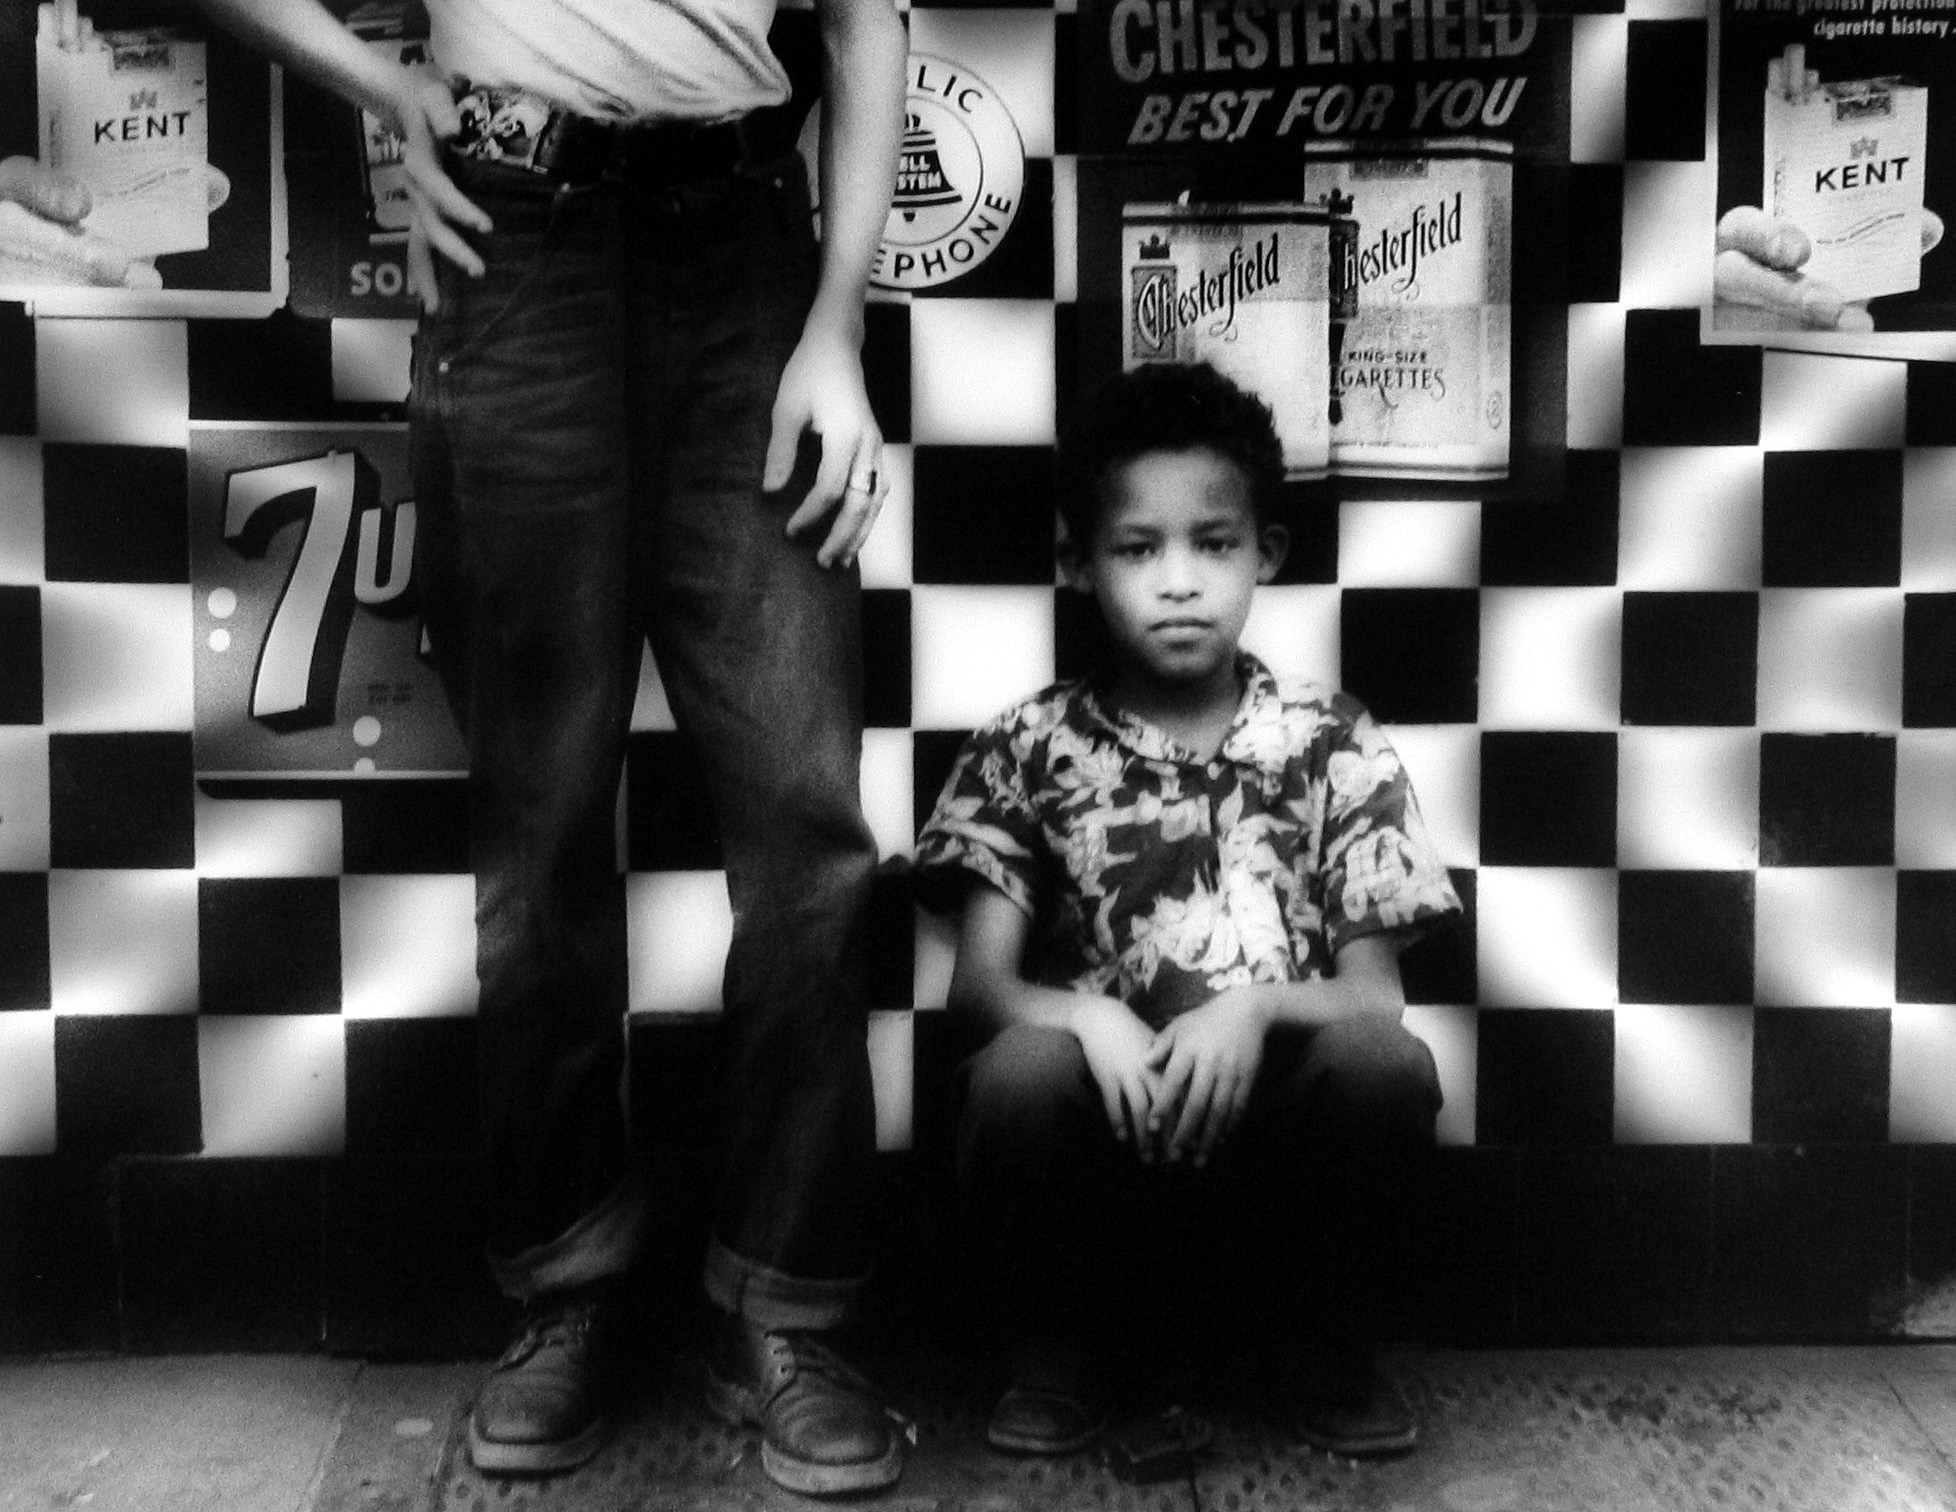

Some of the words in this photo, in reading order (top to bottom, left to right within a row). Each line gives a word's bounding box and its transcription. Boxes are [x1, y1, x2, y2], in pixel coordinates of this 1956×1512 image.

[1109, 0, 1538, 83] CHESTERFIELD
[1813, 17, 1885, 40] cigarette
[916, 64, 984, 114] LIC
[1127, 89, 1275, 145] BEST
[1276, 84, 1395, 137] FOR
[1411, 77, 1528, 129] YOU
[94, 112, 192, 145] KENT
[897, 170, 942, 190] STEM
[1815, 157, 1911, 194] KENT
[1343, 188, 1463, 300] hesterfield
[350, 261, 403, 296] SO
[1136, 231, 1280, 350] Chesterfield
[1340, 366, 1447, 409] GARETTES
[223, 448, 421, 719] 7U
